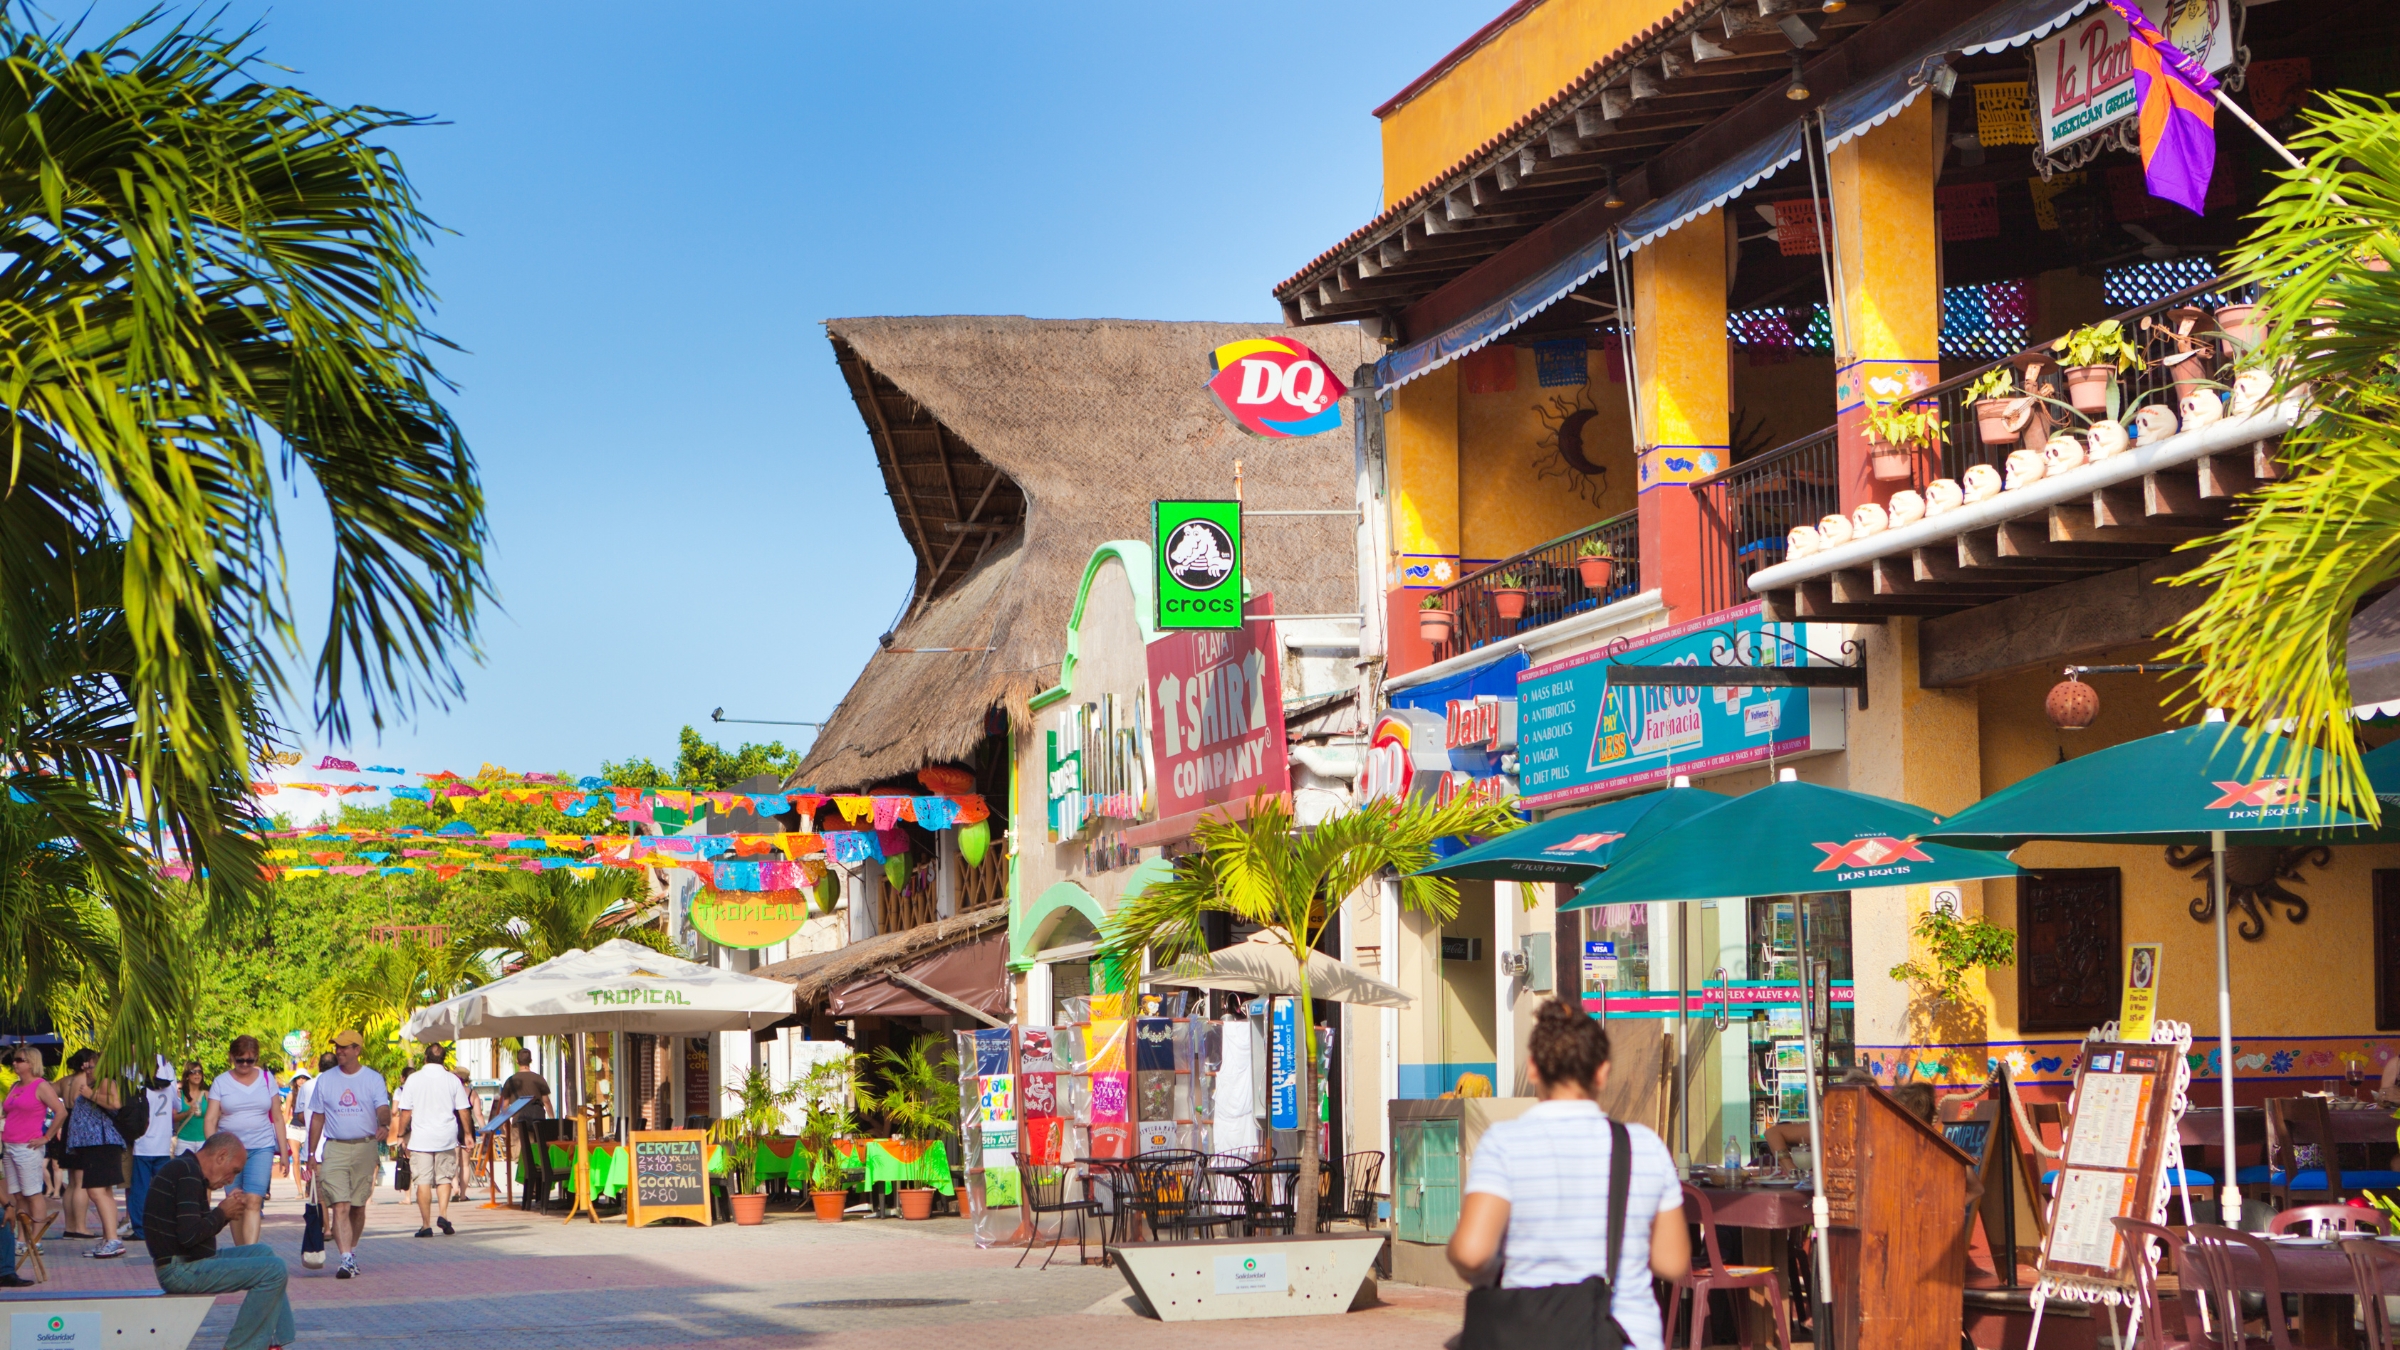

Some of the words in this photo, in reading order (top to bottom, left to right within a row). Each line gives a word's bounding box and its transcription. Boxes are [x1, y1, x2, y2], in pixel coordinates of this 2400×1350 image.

[2080, 19, 2134, 108] Parr
[2051, 104, 2103, 141] MEXICAN
[2105, 87, 2137, 116] GRILL
[1237, 359, 1325, 413] DQ
[1166, 599, 1234, 612] crocs
[1198, 632, 1229, 667] PLAYA
[1531, 686, 1550, 702] MASS
[1552, 679, 1574, 697] RELAX
[1157, 647, 1267, 758] T-SHIRT
[1532, 700, 1576, 723] ANTIBIOTICS
[1446, 695, 1499, 752] Dairy
[1604, 710, 1618, 733] PAY
[1532, 722, 1573, 743] ANABOLICS
[1533, 747, 1559, 764] VIAGRA
[1599, 732, 1626, 763] LESS
[1173, 737, 1265, 799] COMPANY
[1533, 771, 1549, 785] DIET
[1551, 765, 1570, 781] PILLS
[2229, 809, 2259, 819] DOS
[2263, 806, 2309, 817] EQUIS
[1837, 870, 1866, 882] DOS
[1868, 866, 1911, 877] EQUIS
[698, 903, 803, 921] TROPICAL
[587, 988, 691, 1005] TROPICAL
[1756, 990, 1783, 999] ALEVE
[689, 1060, 709, 1071] coff
[1272, 1024, 1285, 1116] infinitum
[980, 1077, 1012, 1095] playa
[1286, 1083, 1294, 1105] ápida
[155, 1094, 167, 1117] 2
[982, 1093, 1009, 1108] del
[636, 1142, 699, 1155] CERVEZA
[982, 1136, 996, 1145] 5th
[998, 1135, 1016, 1144] AVE
[675, 1164, 697, 1172] SOL
[638, 1177, 702, 1189] COCKTAIL
[1235, 1272, 1267, 1280] Solidaridad
[37, 1333, 76, 1341] Solidaridad
